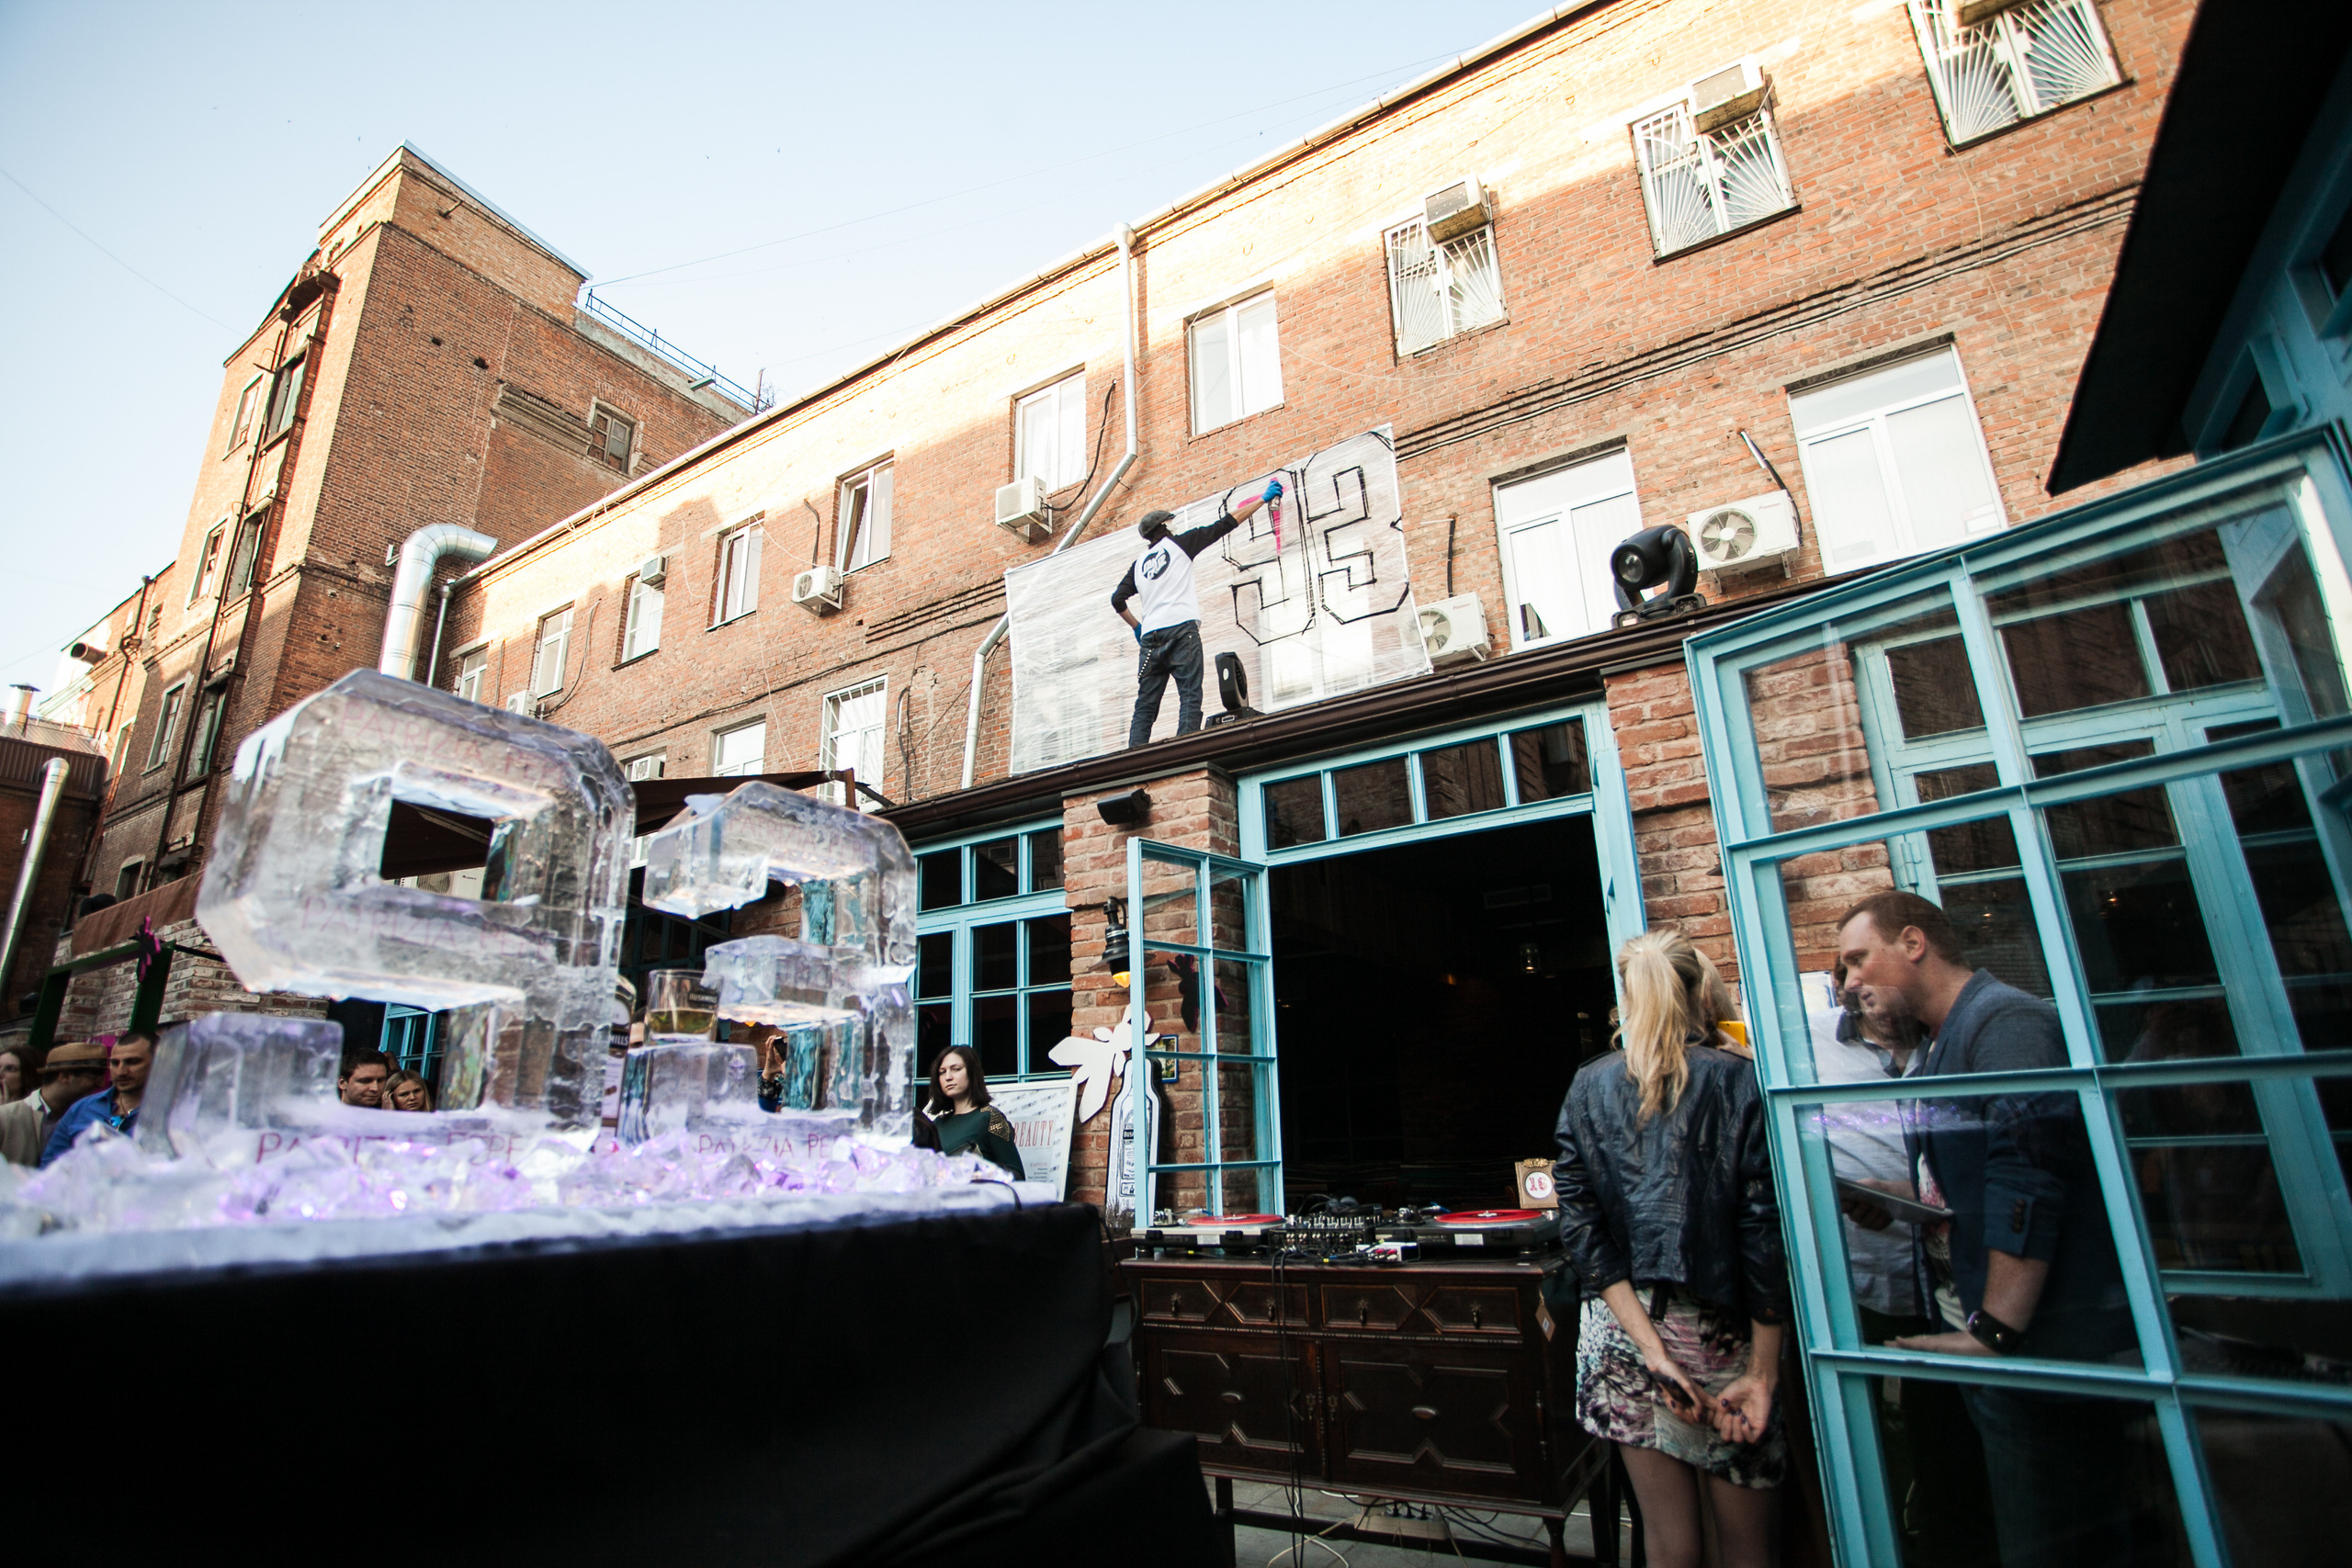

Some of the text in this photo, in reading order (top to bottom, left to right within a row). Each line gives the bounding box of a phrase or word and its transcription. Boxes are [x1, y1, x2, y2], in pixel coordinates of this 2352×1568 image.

[339, 700, 485, 768] PATRIZIA
[300, 896, 458, 949] PATRIZIA
[689, 992, 718, 1004] BUSHMILLS
[1013, 1120, 1055, 1148] BEAUTY
